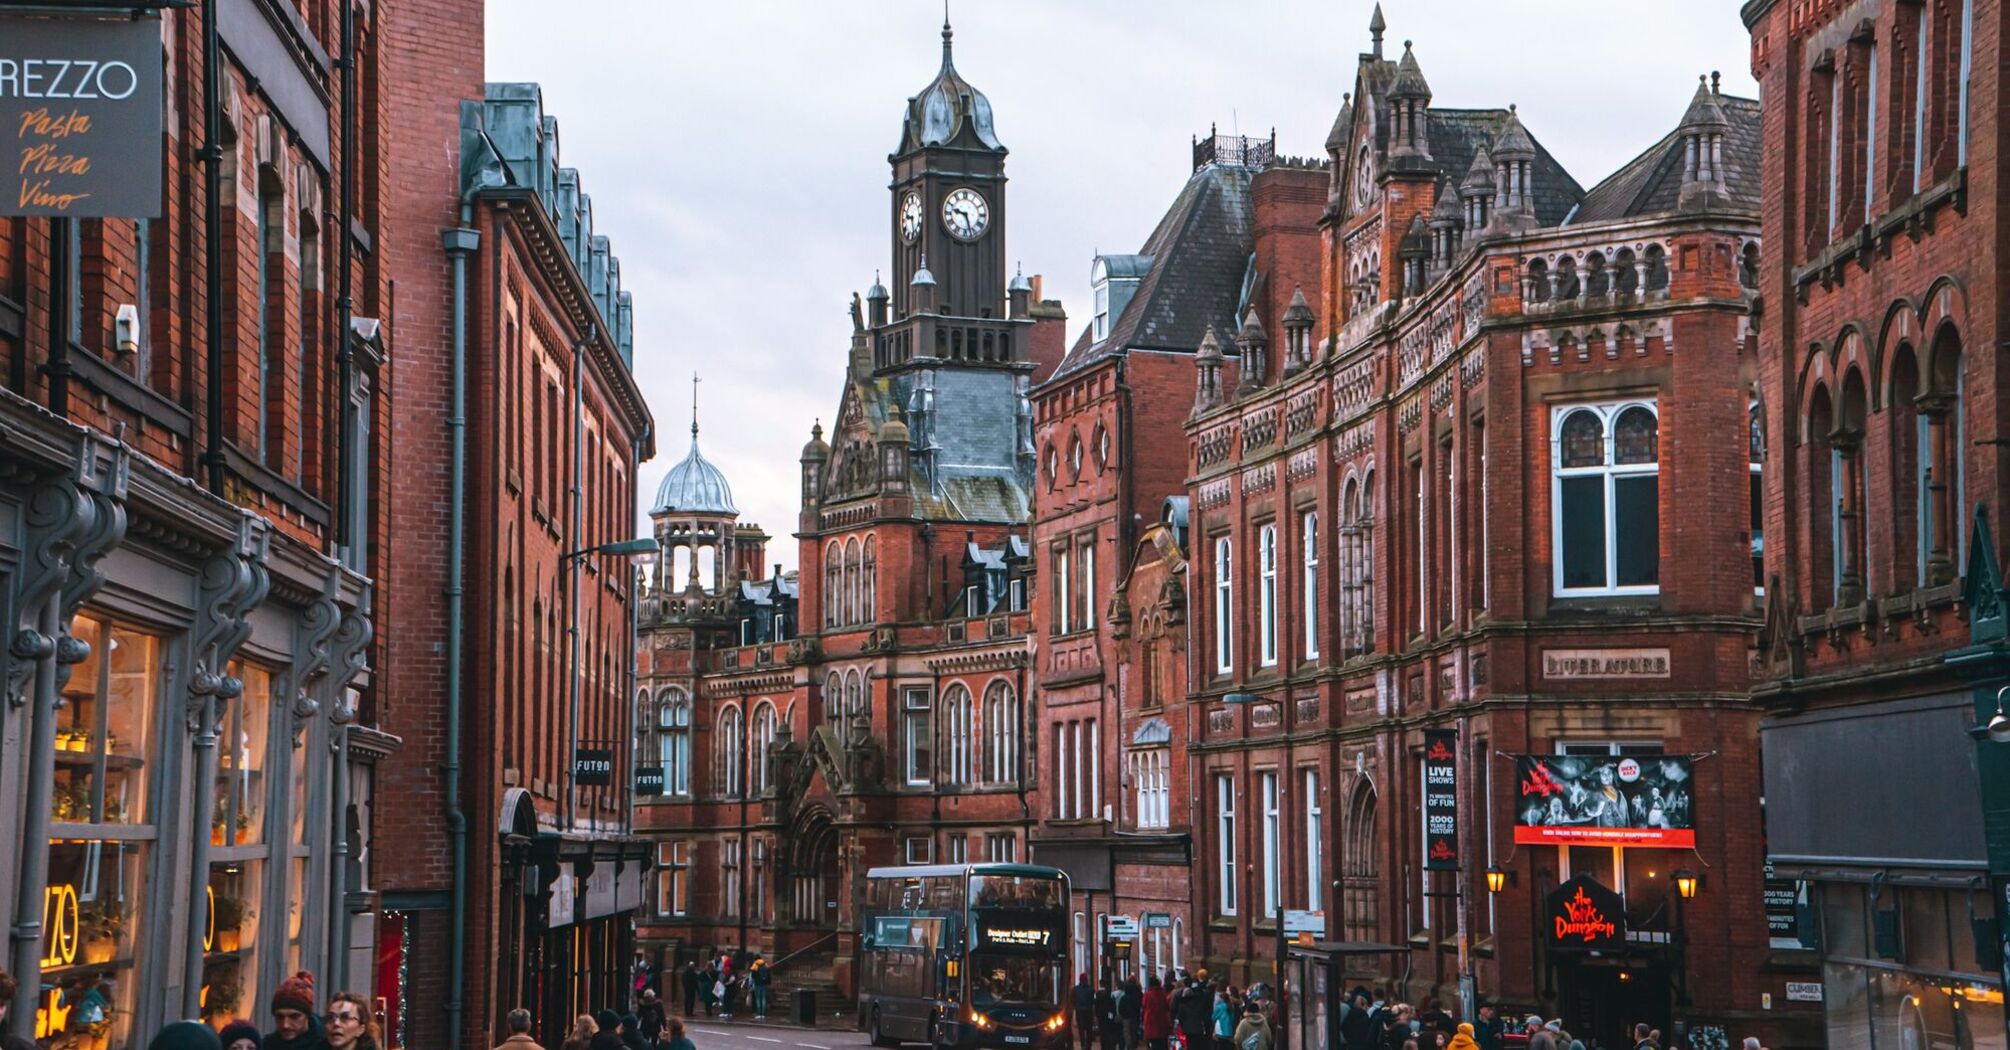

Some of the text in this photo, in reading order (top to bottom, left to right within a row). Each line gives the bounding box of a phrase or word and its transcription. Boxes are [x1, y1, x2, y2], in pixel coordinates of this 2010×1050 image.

[0, 59, 137, 99] REZZO
[18, 107, 92, 138] Pasta
[19, 144, 91, 175] Pizza
[19, 178, 91, 209] Vino
[577, 760, 610, 771] FUTON
[1428, 766, 1453, 777] LIVE
[637, 775, 663, 784] FUTON
[1430, 815, 1454, 823] 2000
[988, 929, 1010, 937] Designer
[1555, 915, 1615, 942] Dungeon
[1043, 931, 1050, 945] 7
